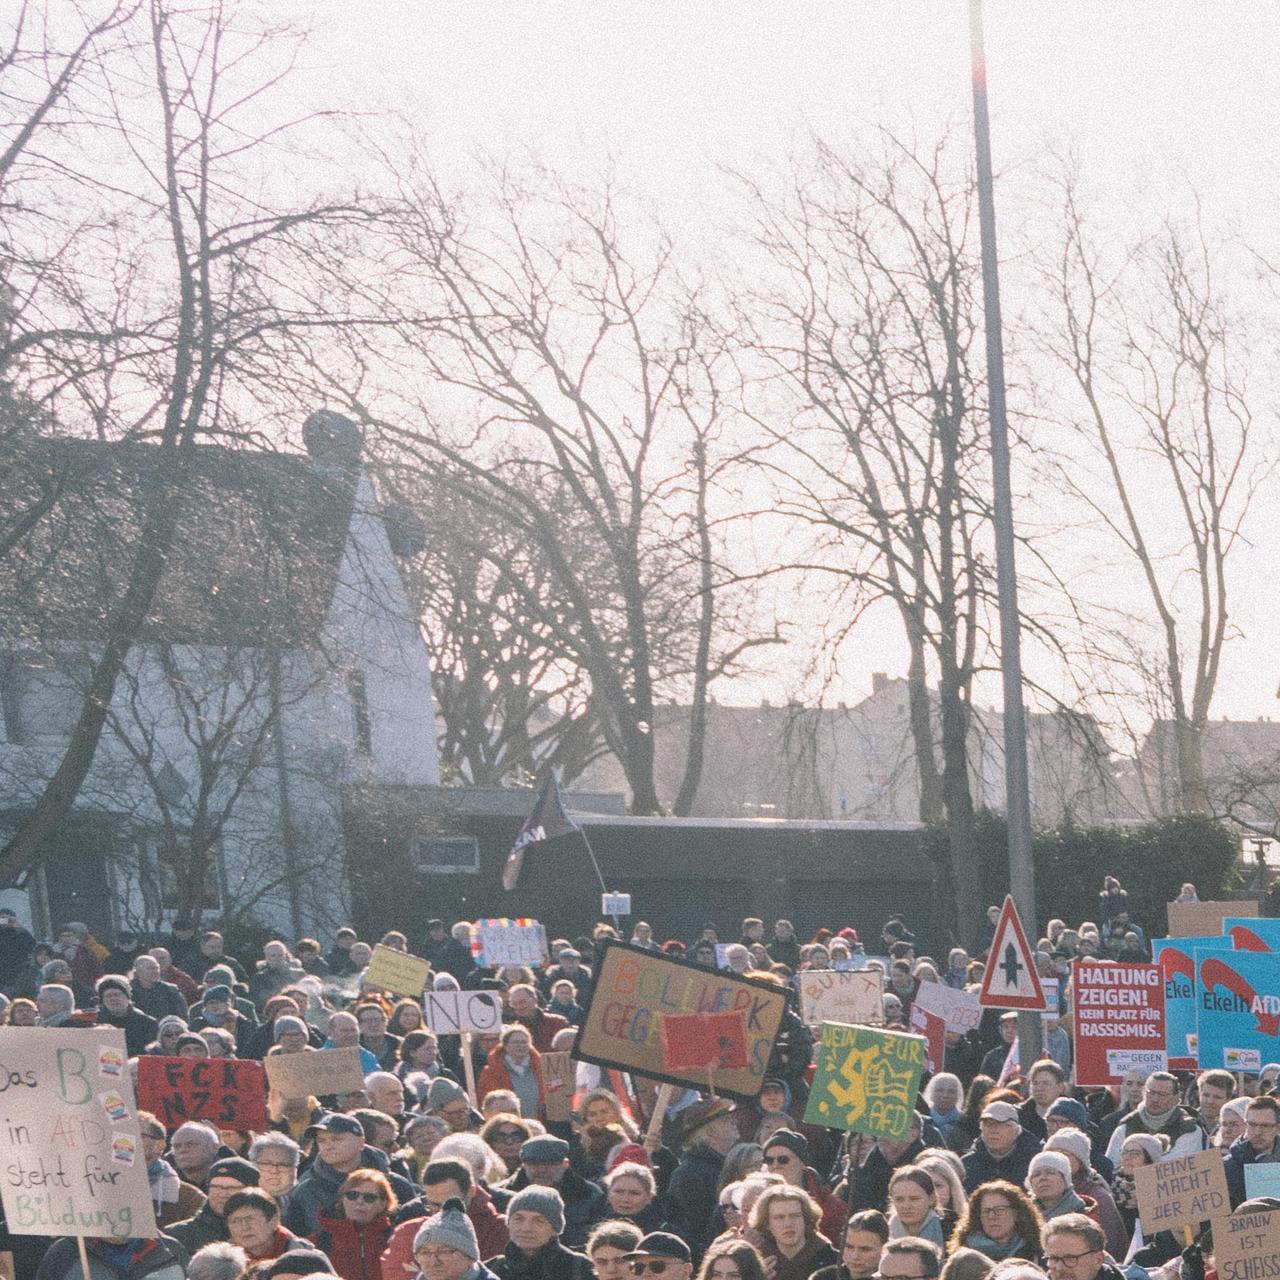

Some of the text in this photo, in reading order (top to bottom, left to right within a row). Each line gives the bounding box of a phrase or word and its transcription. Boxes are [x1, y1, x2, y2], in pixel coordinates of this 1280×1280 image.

[806, 974, 878, 1000] BUNT
[1079, 968, 1158, 986] HALTUNG
[1079, 989, 1147, 1005] ZEIGEN!
[429, 993, 497, 1031] NO
[1079, 1007, 1160, 1021] KEIN PLATZ FÜR
[1080, 1023, 1161, 1038] RASSISMUS.
[883, 1034, 922, 1065] ZUR
[1131, 1053, 1162, 1063] GEGEN
[57, 1048, 92, 1105] B
[164, 1062, 240, 1089] FCK
[162, 1091, 239, 1123] NZS
[869, 1101, 909, 1136] AFD
[6, 1114, 107, 1148] in AfD
[7, 1155, 121, 1197] steht für
[1155, 1156, 1198, 1180] KEINE
[1156, 1169, 1212, 1198] MACHT
[15, 1195, 133, 1236] Bildung
[1152, 1191, 1224, 1221] DER AFD
[1229, 1214, 1273, 1233] BRAUN
[1240, 1233, 1267, 1250] IST
